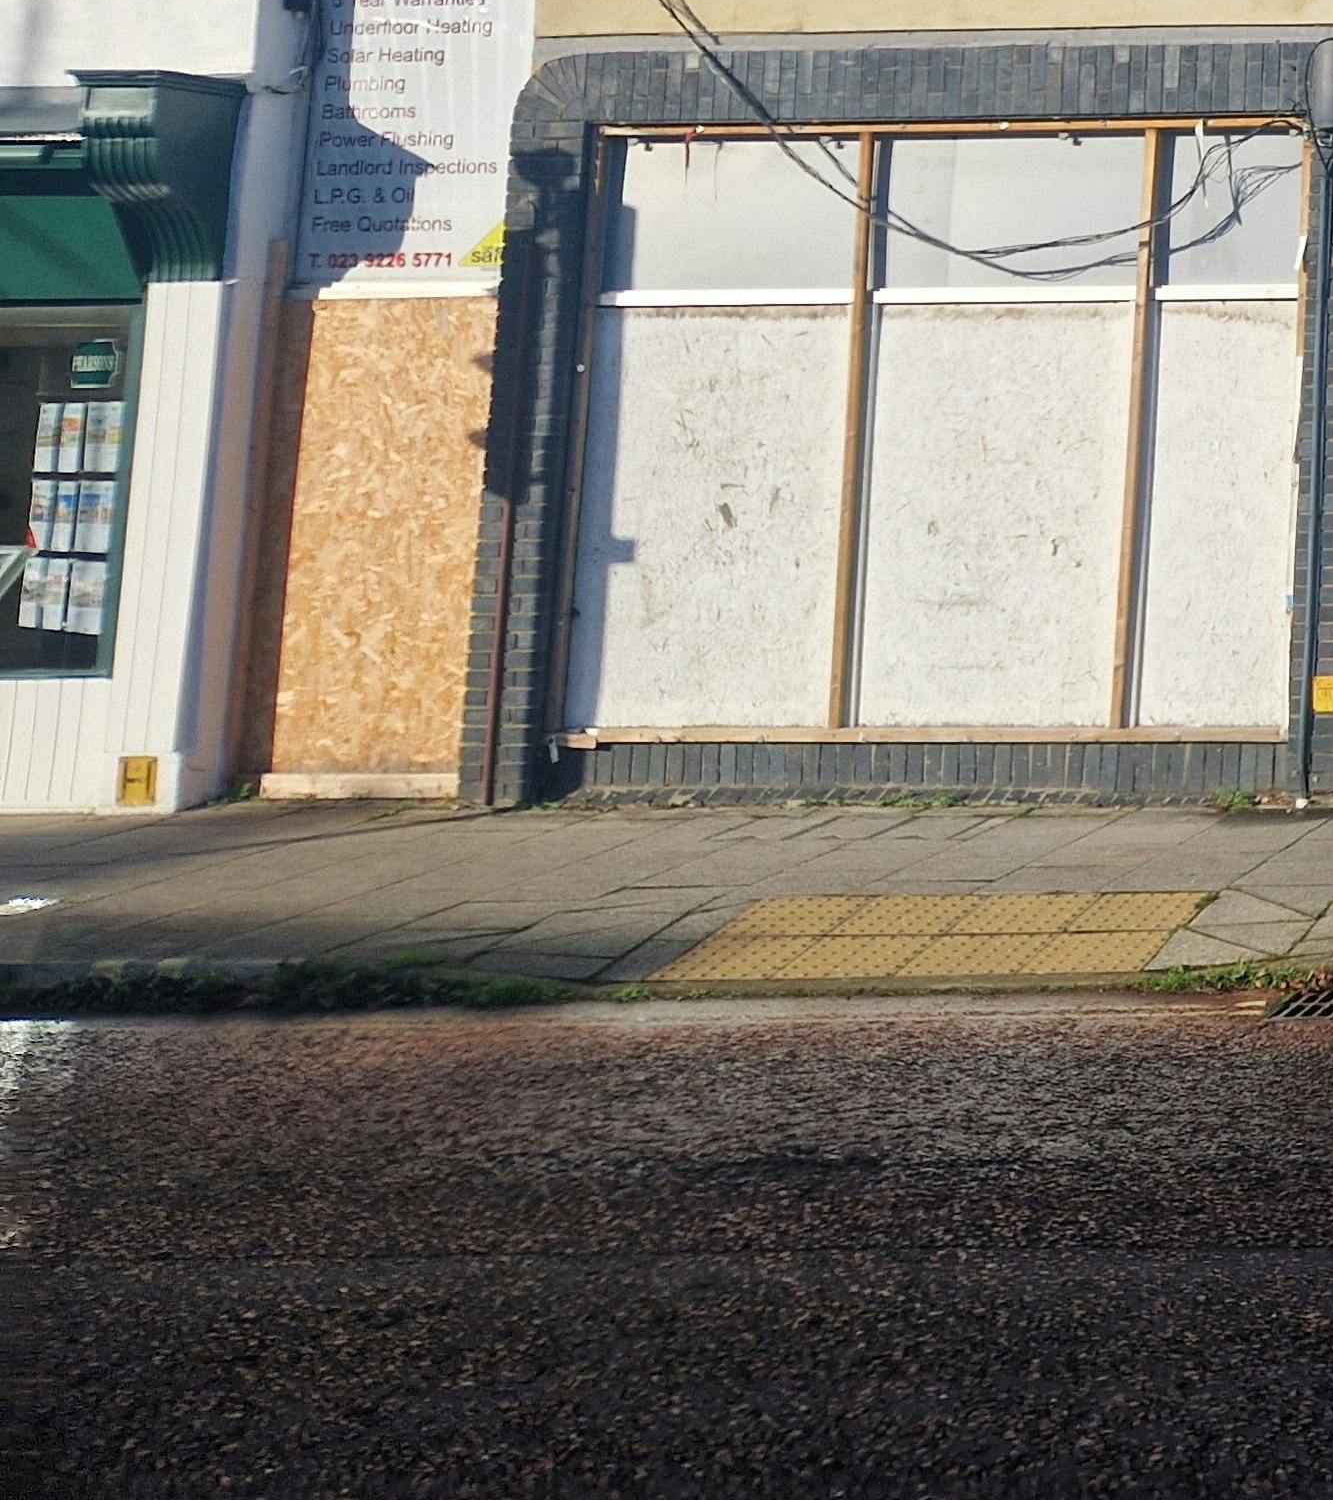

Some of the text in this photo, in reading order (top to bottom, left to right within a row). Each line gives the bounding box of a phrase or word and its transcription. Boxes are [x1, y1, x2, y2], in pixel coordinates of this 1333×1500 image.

[330, 18, 493, 38] Underfloor Heating
[327, 47, 445, 66] Solar Heating
[324, 76, 406, 94] Plumbing
[321, 104, 417, 120] Bathrooms
[318, 131, 454, 150] Power Flushing
[317, 159, 498, 179] Landlord Inspections
[372, 188, 384, 203] &
[391, 187, 415, 203] Oil
[311, 216, 452, 233] Free Quotations
[327, 253, 359, 269] 023
[364, 252, 406, 269] 9226
[411, 252, 452, 268] 5771
[471, 246, 504, 264] saf
